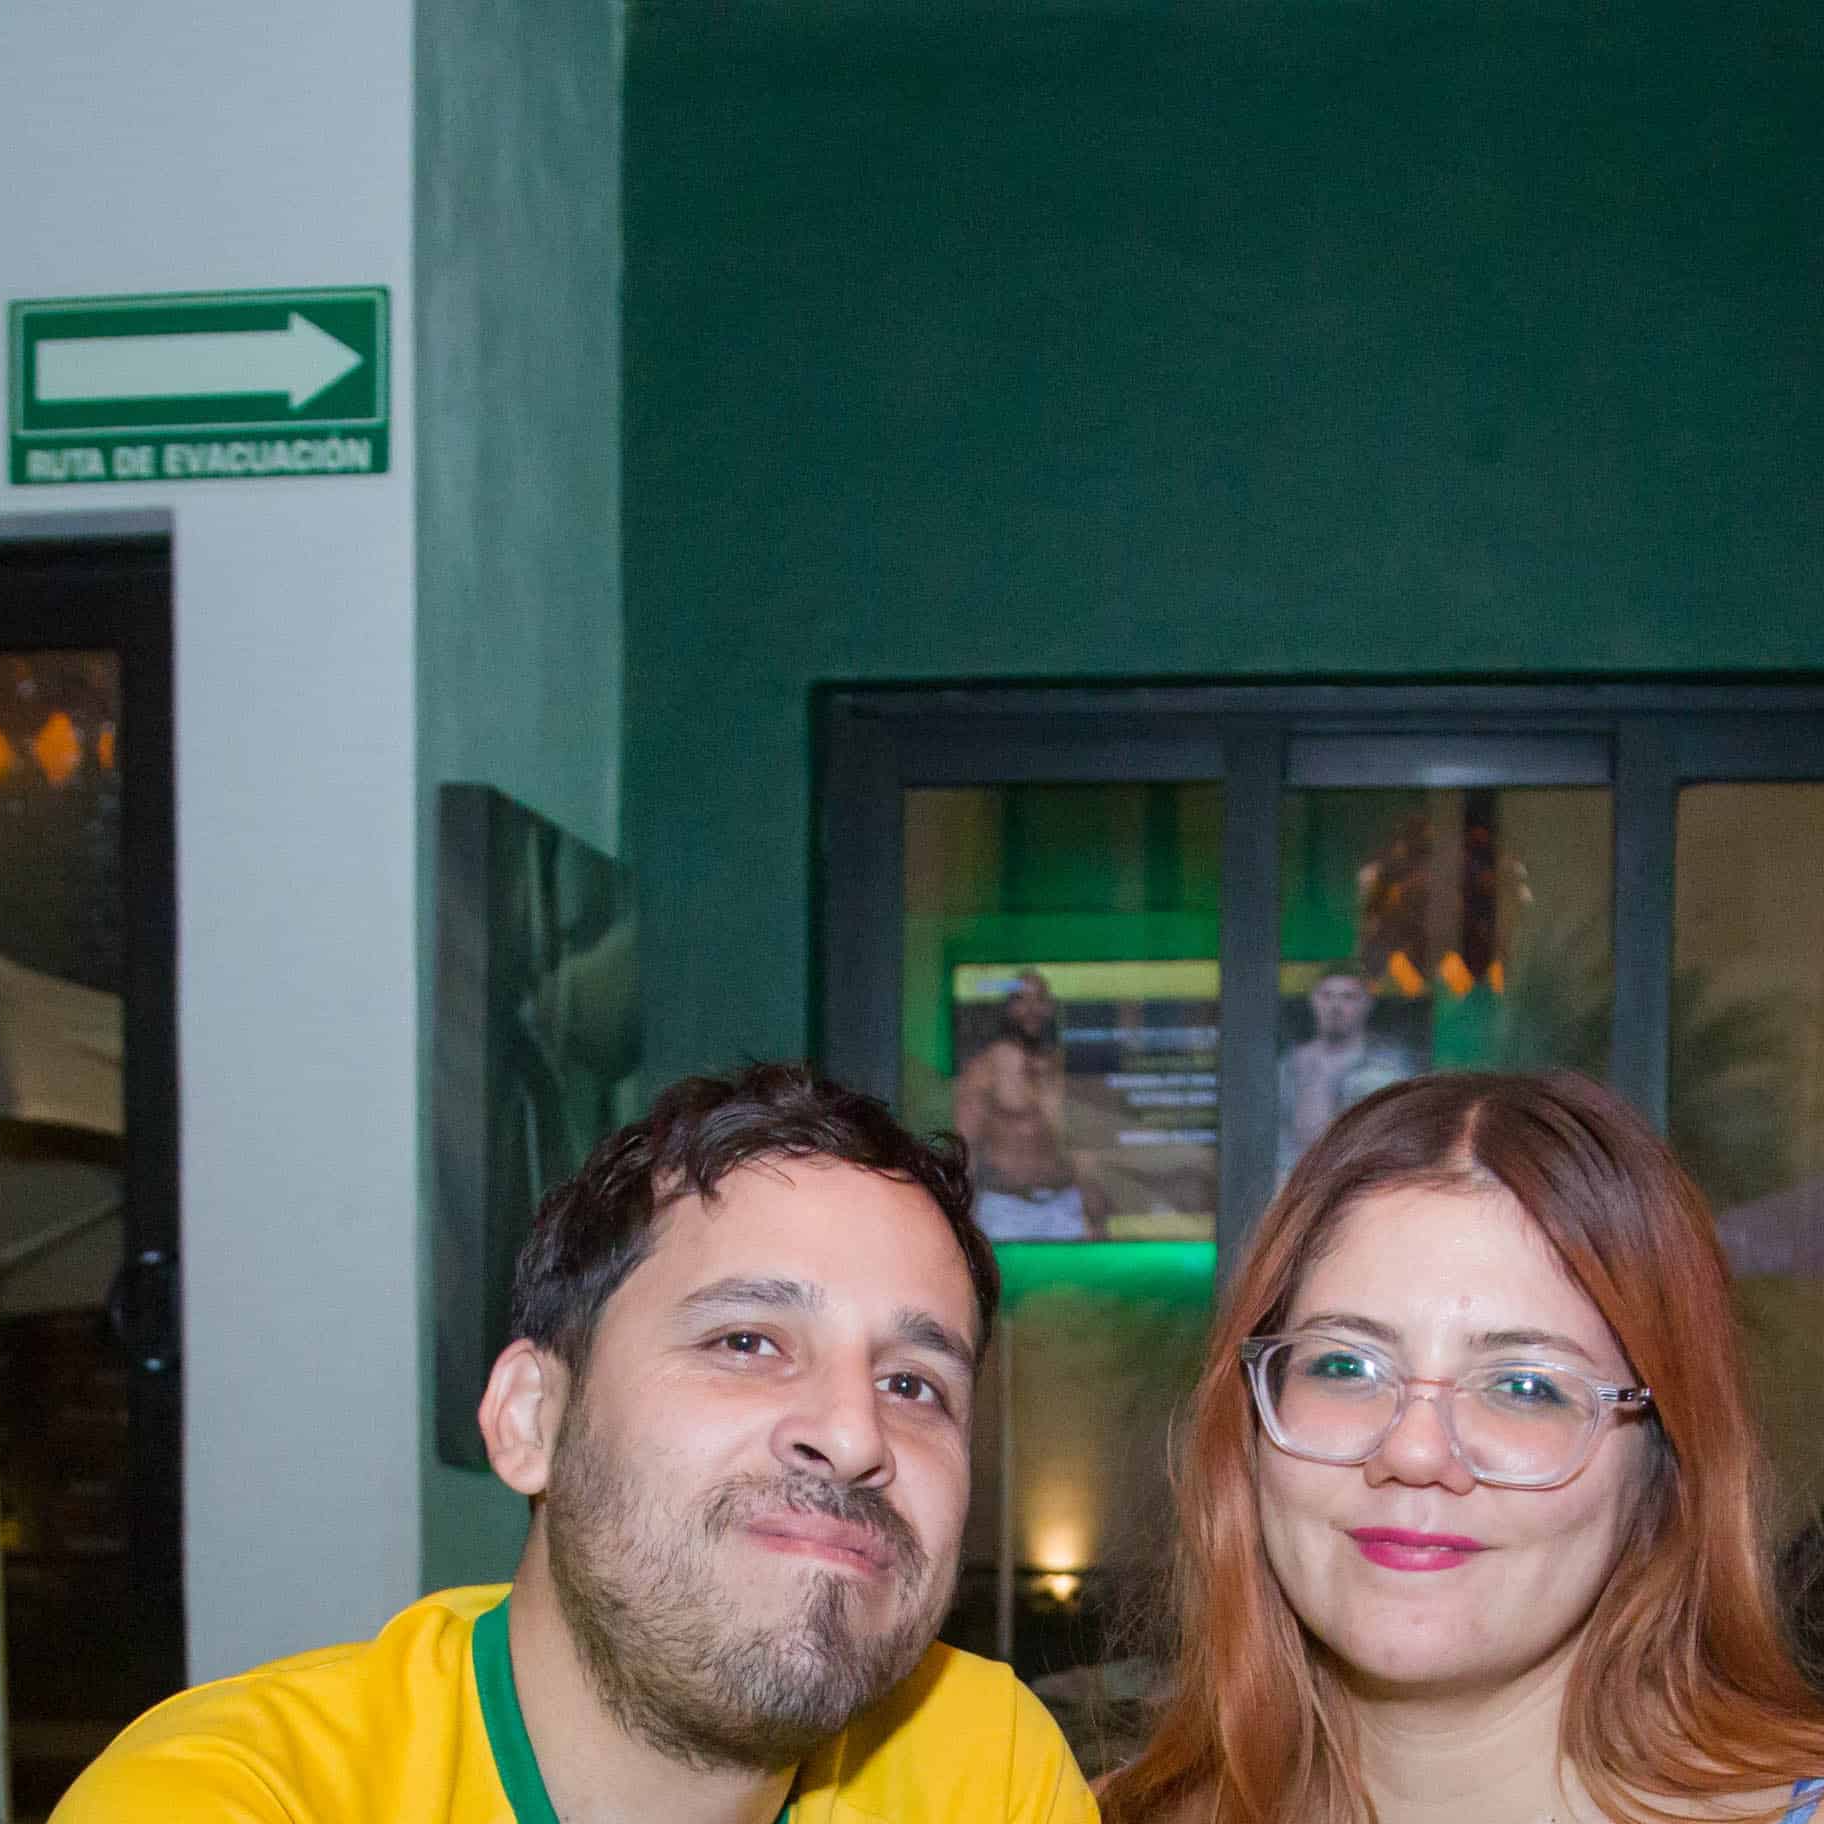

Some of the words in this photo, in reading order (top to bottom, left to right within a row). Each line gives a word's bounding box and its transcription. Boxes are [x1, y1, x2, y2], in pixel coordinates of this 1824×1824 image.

[25, 448, 106, 480] RUTA
[112, 445, 157, 477] DE
[162, 434, 373, 475] EVACUACIÓN
